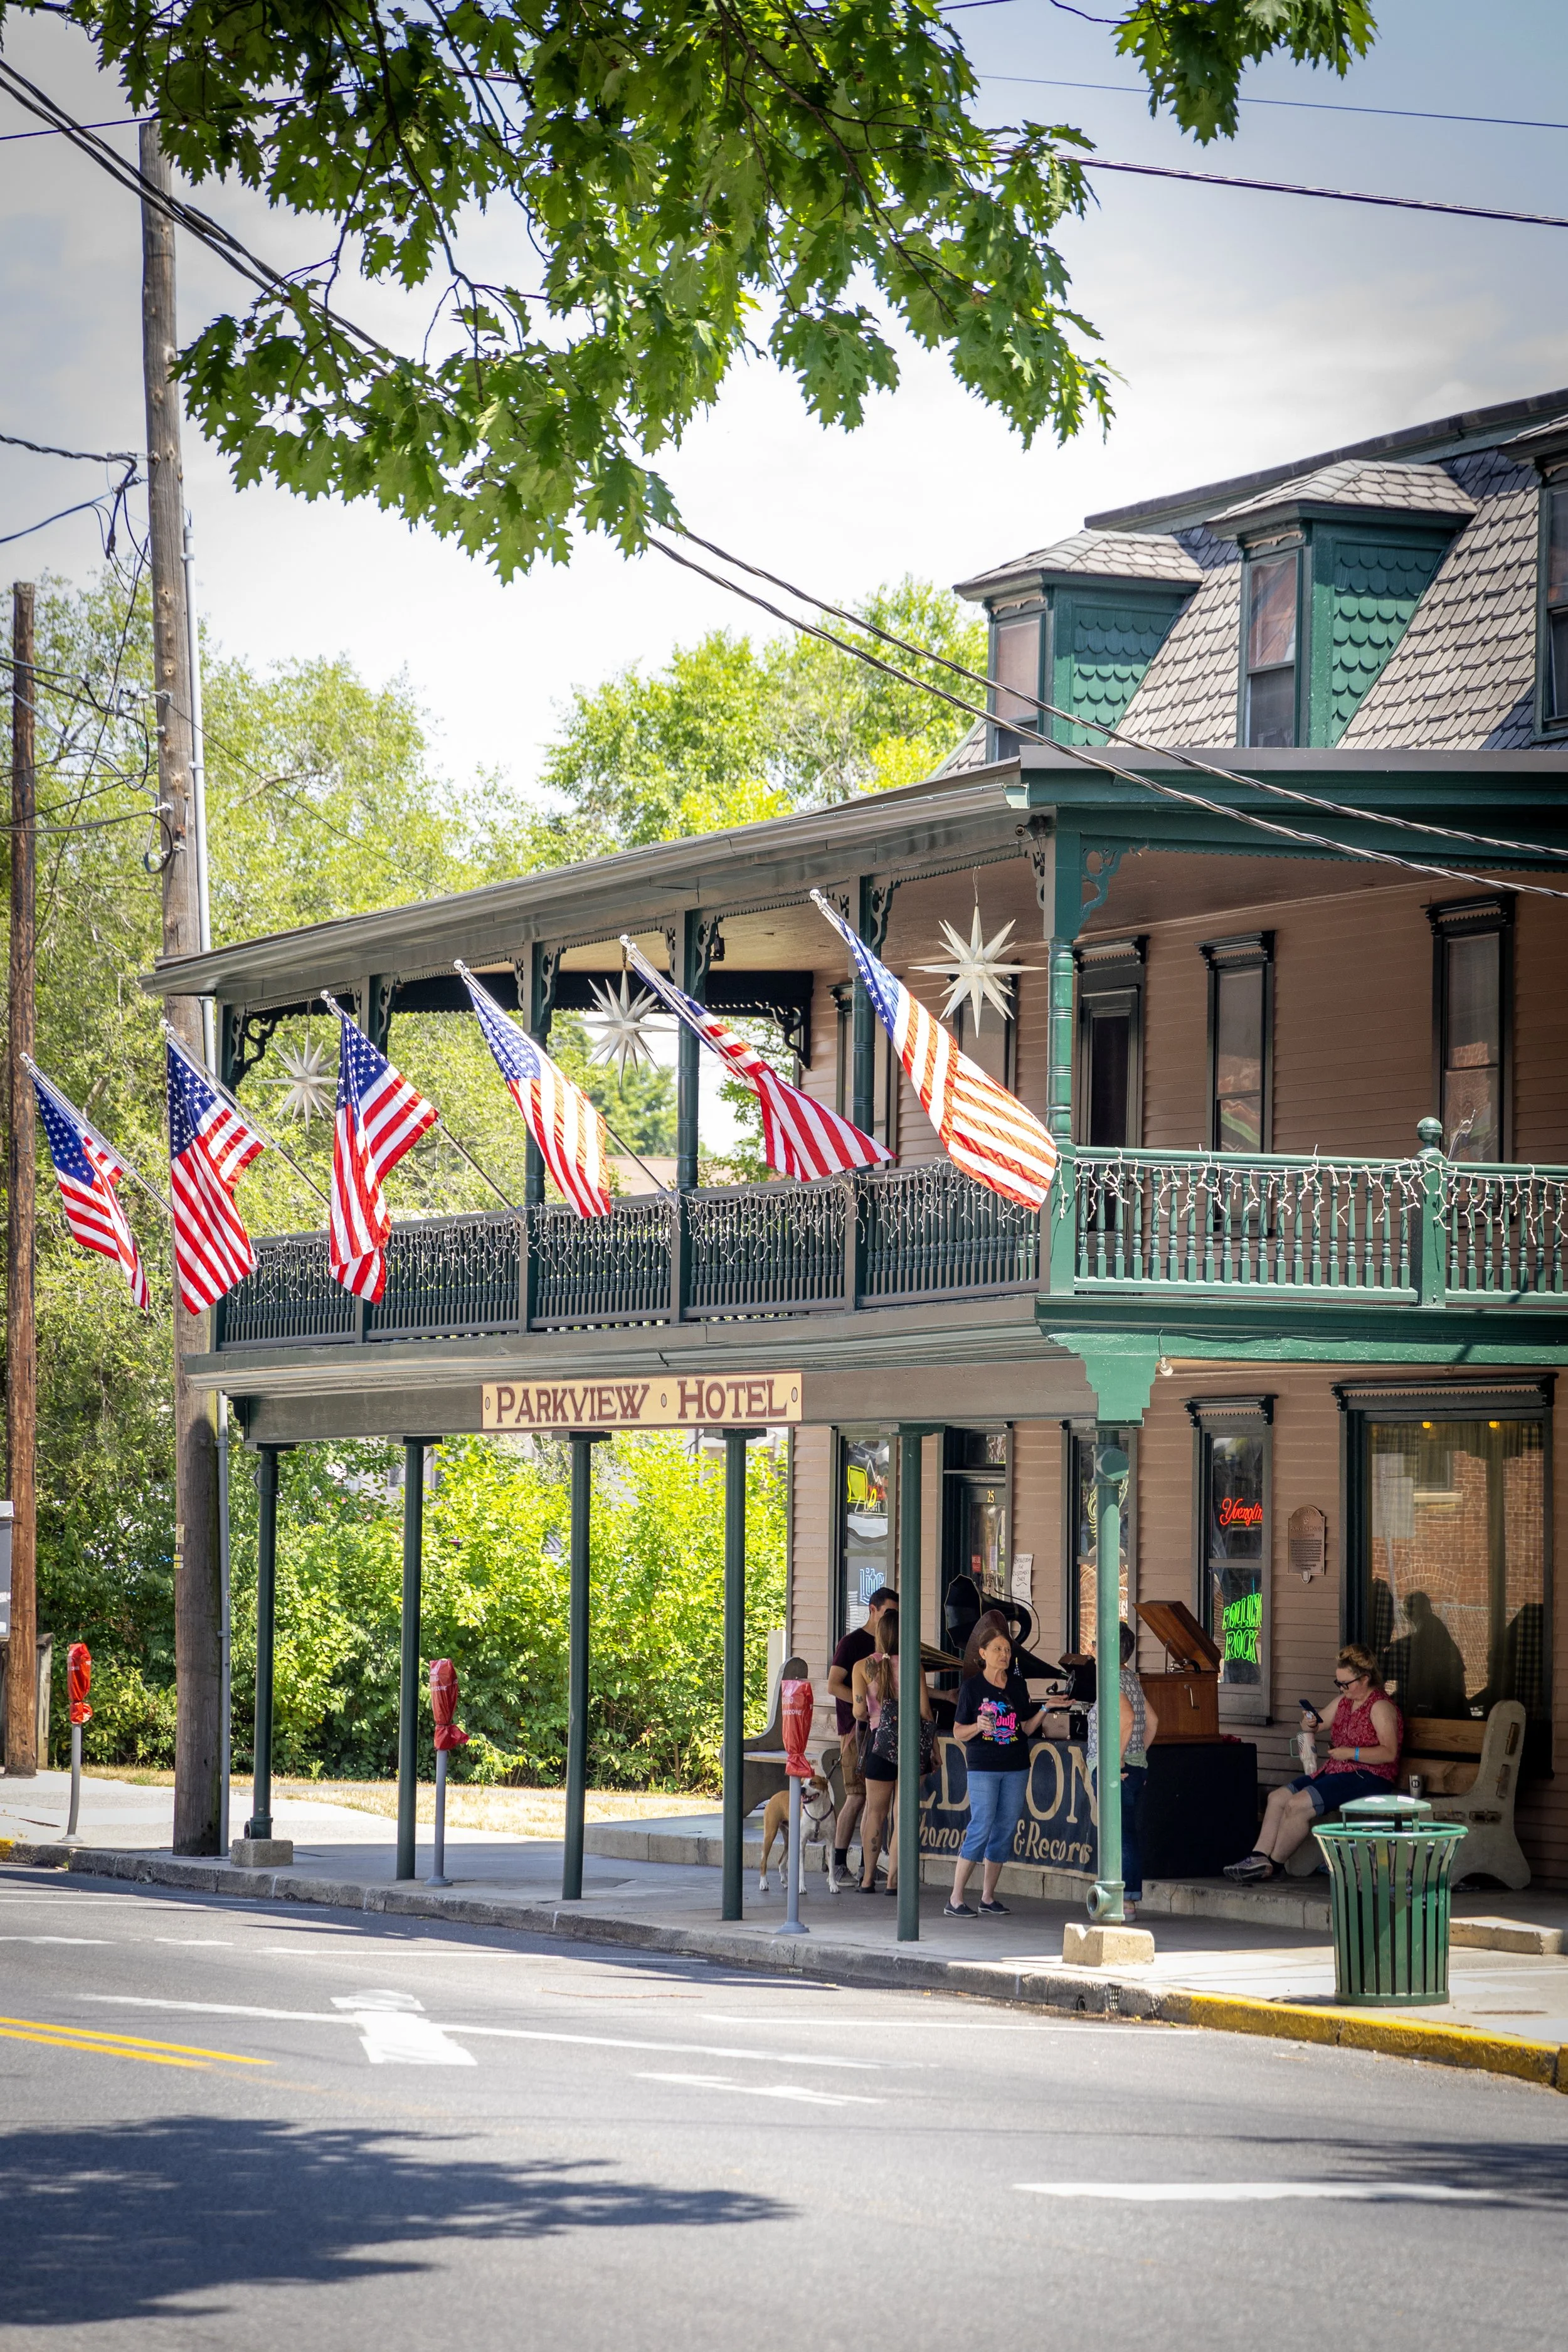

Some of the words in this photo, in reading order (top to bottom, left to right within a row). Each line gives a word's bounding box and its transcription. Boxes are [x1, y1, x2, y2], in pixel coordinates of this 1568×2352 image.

[496, 1384, 650, 1423] PARKVIEW
[677, 1379, 787, 1419] HOTEL
[987, 1490, 995, 1503] 25
[1219, 1498, 1263, 1527] Yuenglin
[1222, 1593, 1262, 1630] ROLLIN
[1225, 1629, 1259, 1663] ROCK
[995, 1715, 1015, 1729] July
